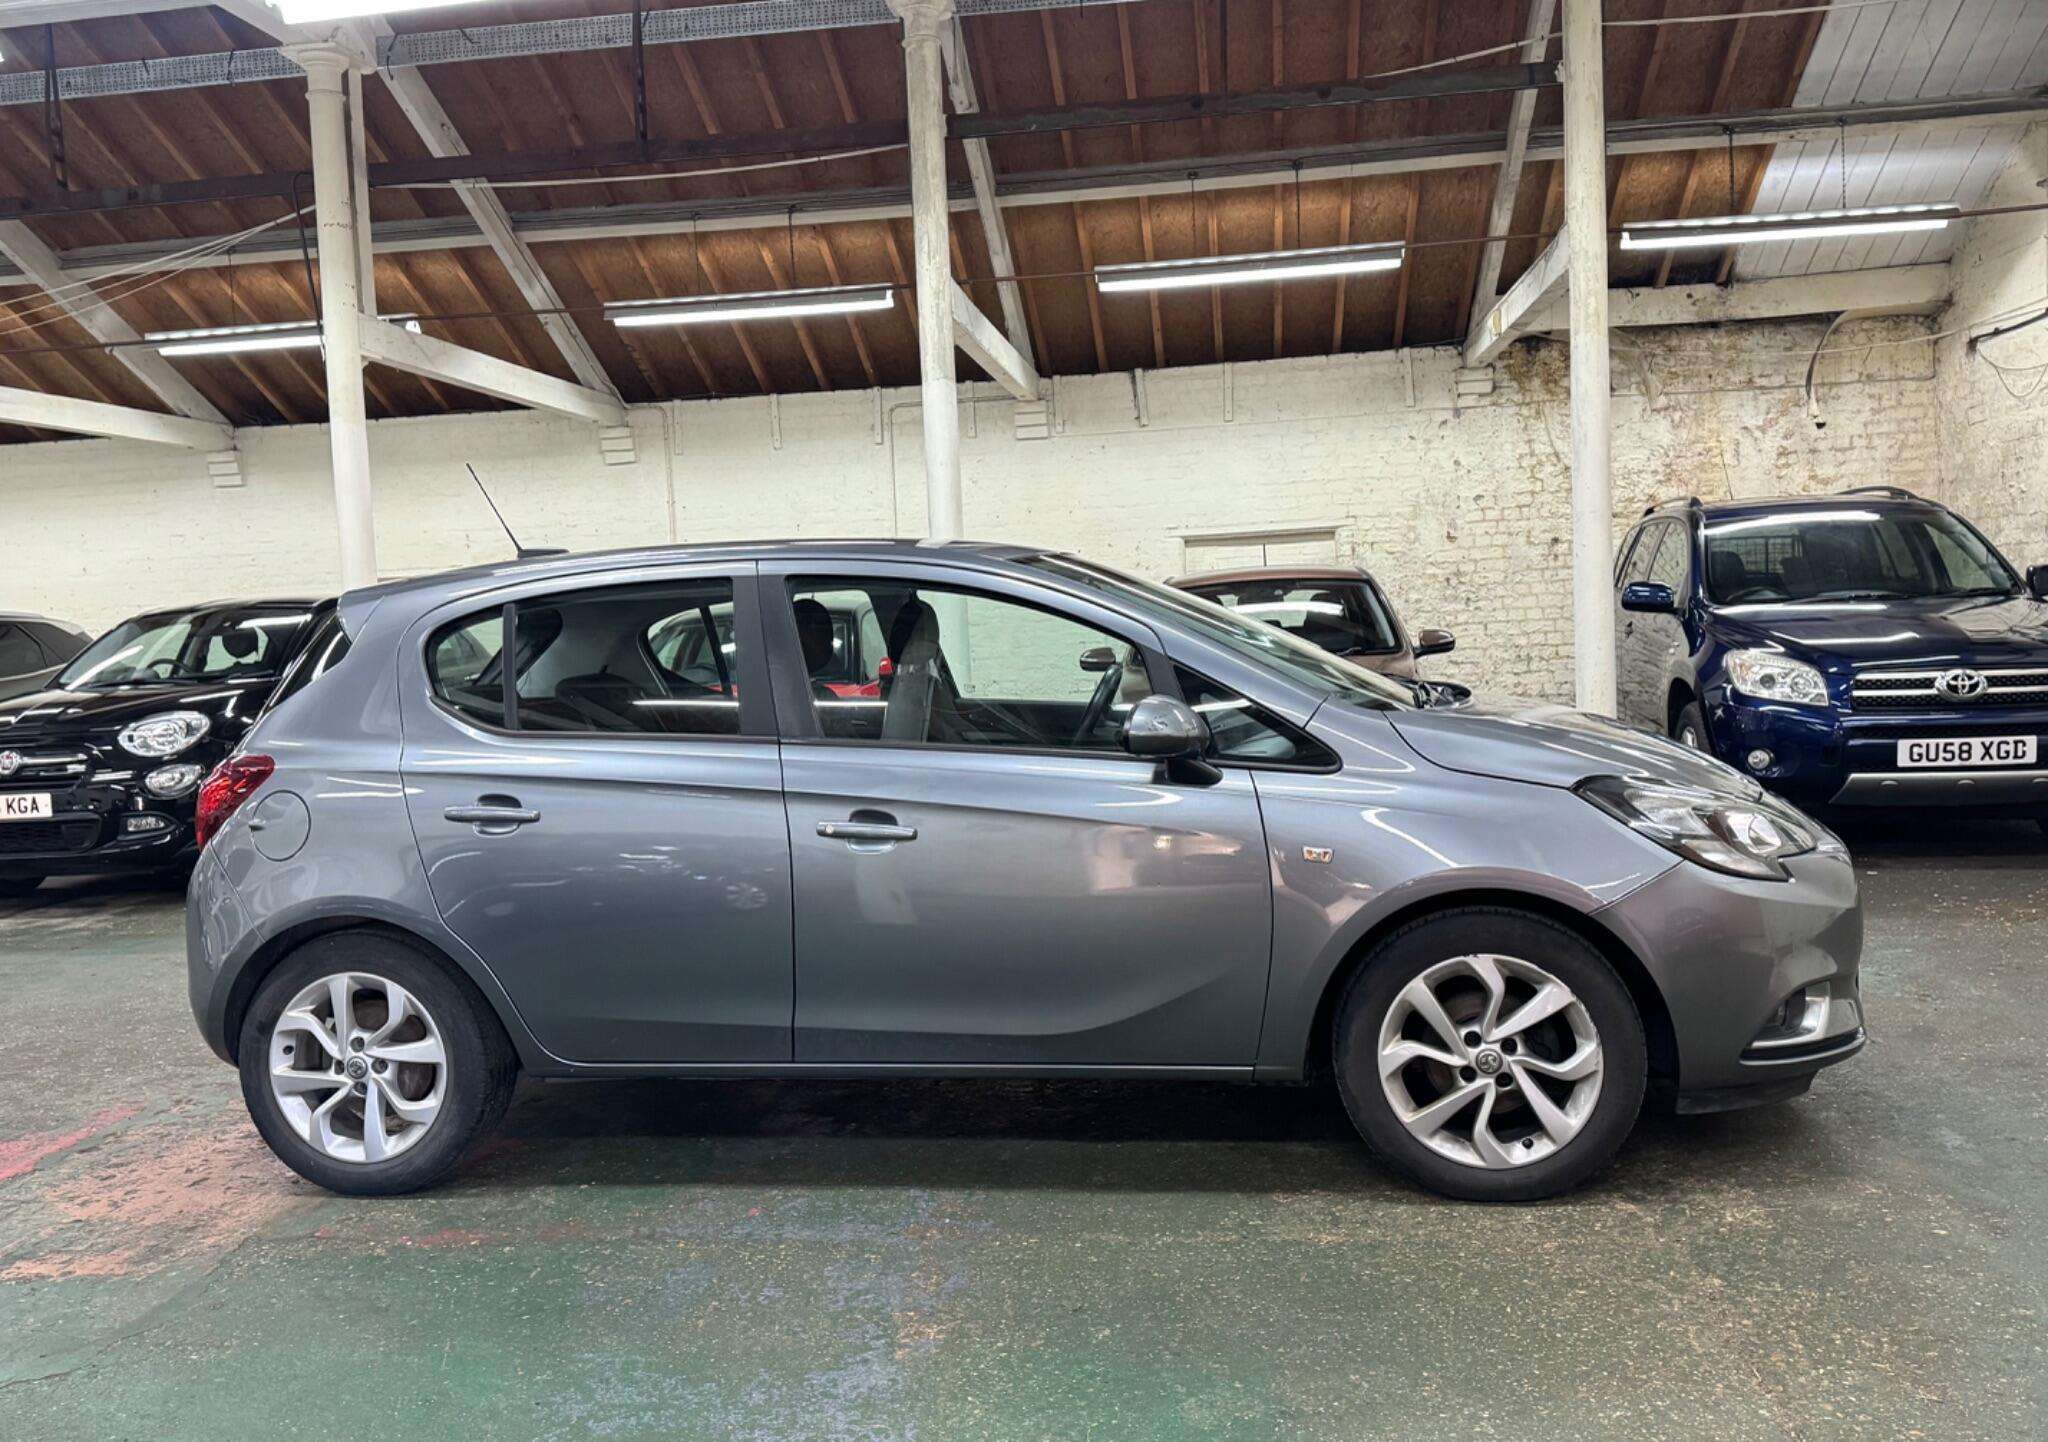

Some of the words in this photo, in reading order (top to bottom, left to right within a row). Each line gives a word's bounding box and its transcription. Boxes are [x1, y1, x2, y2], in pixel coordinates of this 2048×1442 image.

[1909, 742, 1973, 762] GU58
[1980, 740, 2027, 761] XGD
[6, 796, 40, 814] KGA
